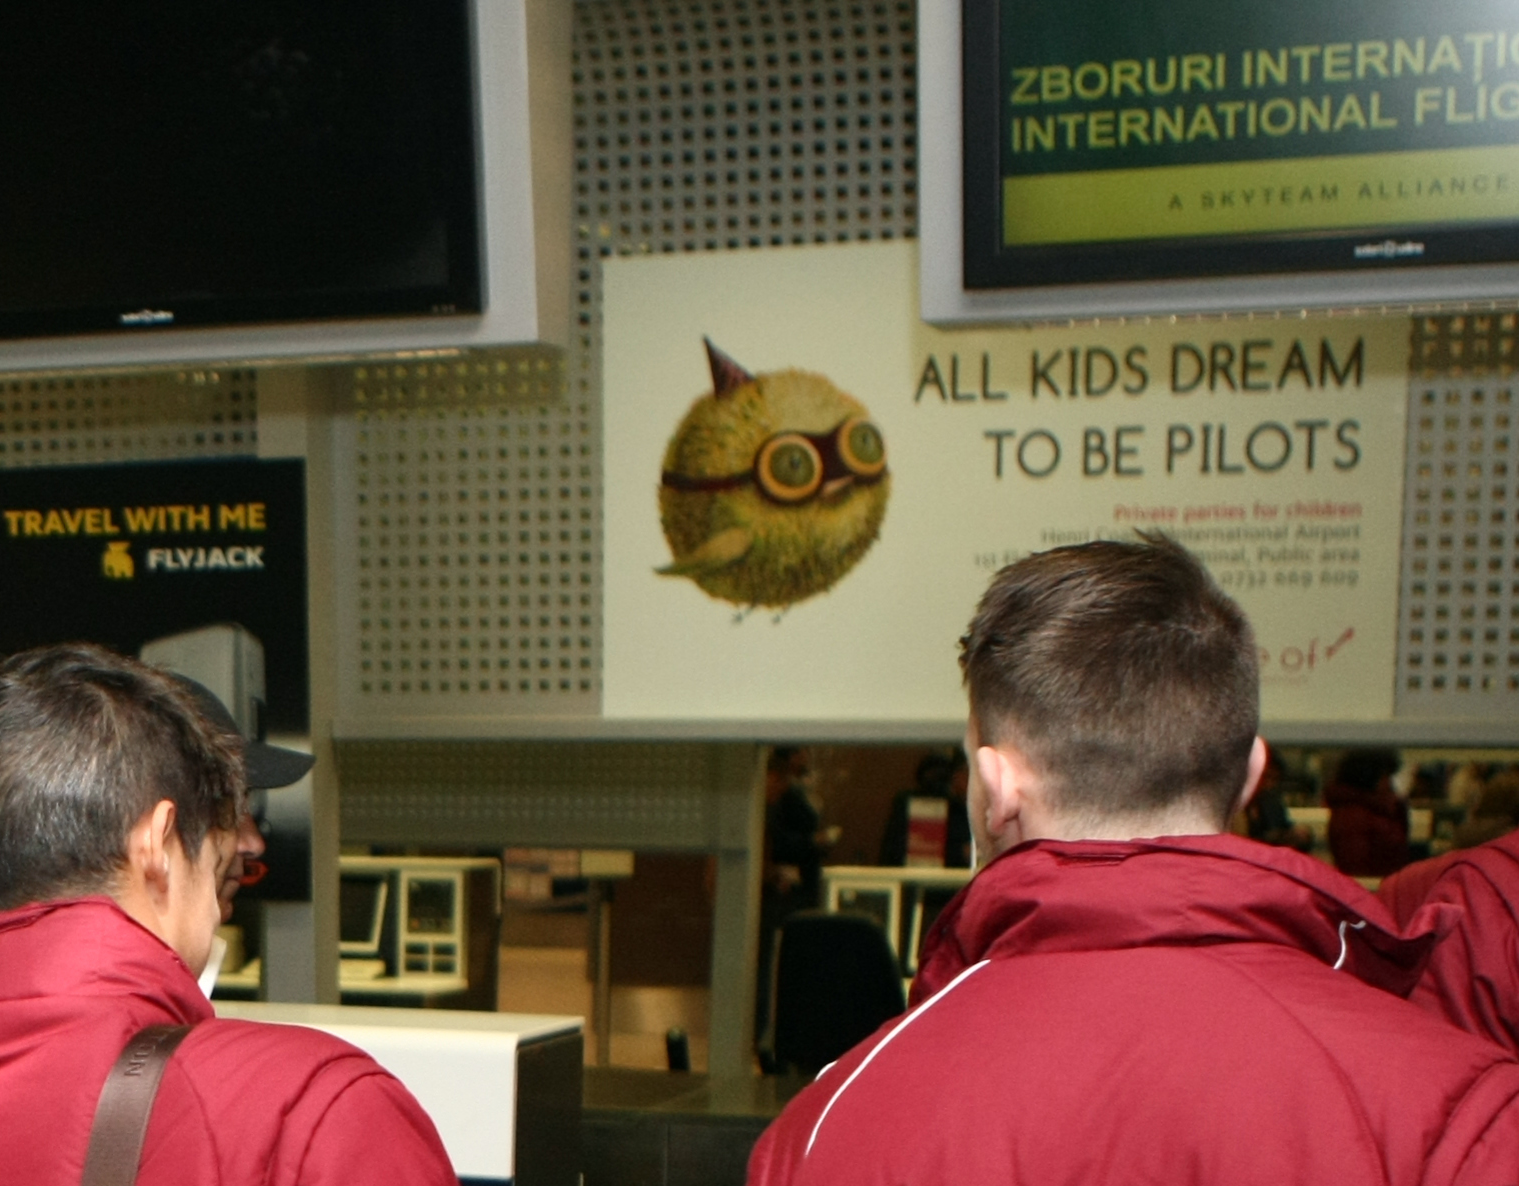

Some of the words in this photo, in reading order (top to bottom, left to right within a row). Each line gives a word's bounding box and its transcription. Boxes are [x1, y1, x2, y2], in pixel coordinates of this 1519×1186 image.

[1011, 53, 1226, 104] ZBORURI
[1011, 93, 1397, 153] INTERNATIONAL
[1170, 194, 1183, 210] A
[1201, 183, 1339, 209] SKYTEAM
[1358, 173, 1510, 200] ALLIANCE
[914, 352, 1008, 402] ALL
[1031, 345, 1150, 398] KIDS
[1171, 336, 1365, 393] DREAM
[984, 430, 1061, 478] TO
[1083, 425, 1144, 476] BE
[1167, 419, 1362, 475] PILOTS
[4, 508, 120, 536] TRAVEL
[124, 504, 211, 533] WITH
[218, 502, 266, 530] ME
[1114, 503, 1179, 522] Private
[1183, 502, 1245, 525] parties
[1253, 501, 1278, 518] for
[1285, 499, 1362, 517] children
[147, 546, 265, 570] FLYJACK
